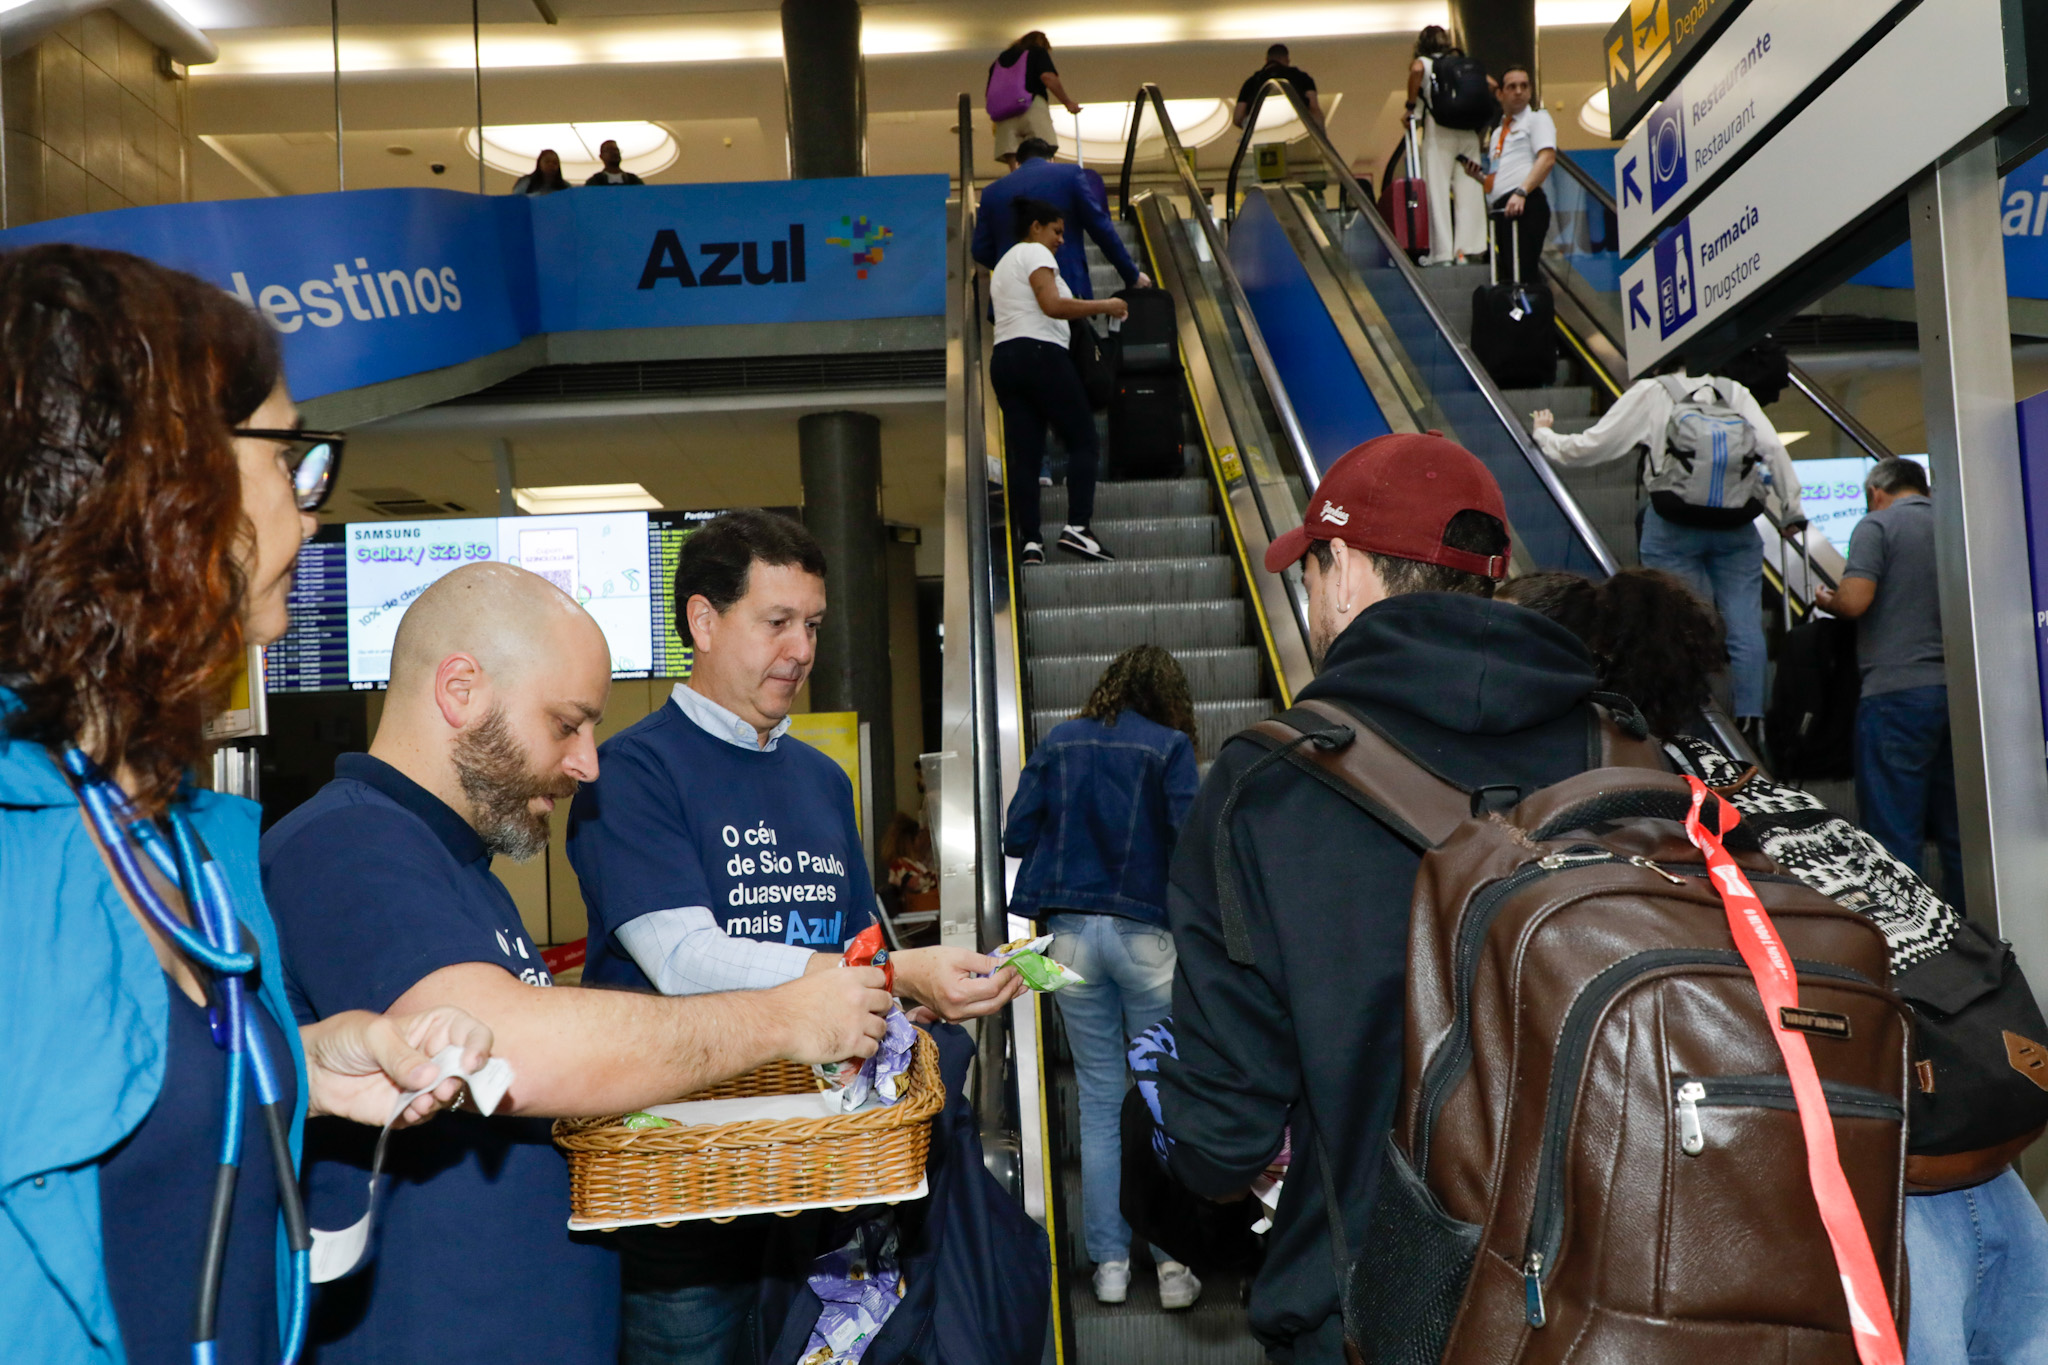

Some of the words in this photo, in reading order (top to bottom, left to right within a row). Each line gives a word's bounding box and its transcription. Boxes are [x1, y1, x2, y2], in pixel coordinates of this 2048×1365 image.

[1675, 0, 1715, 45] Depar
[1691, 32, 1772, 125] Restaurante
[1695, 100, 1756, 172] Restaurant
[637, 222, 806, 292] Azul
[1700, 204, 1760, 266] Farmacia
[1704, 250, 1761, 308] Drugstore
[355, 528, 421, 540] SAMSUNG
[355, 545, 425, 566] Galaxy
[428, 542, 461, 560] S23
[464, 541, 492, 560] 5G
[358, 607, 382, 627] 10%
[382, 597, 399, 612] de
[400, 580, 437, 602] desc
[722, 824, 740, 848] O
[727, 854, 756, 878] de
[797, 850, 845, 878] Paulo
[727, 912, 783, 936] mais
[784, 909, 843, 945] Azul
